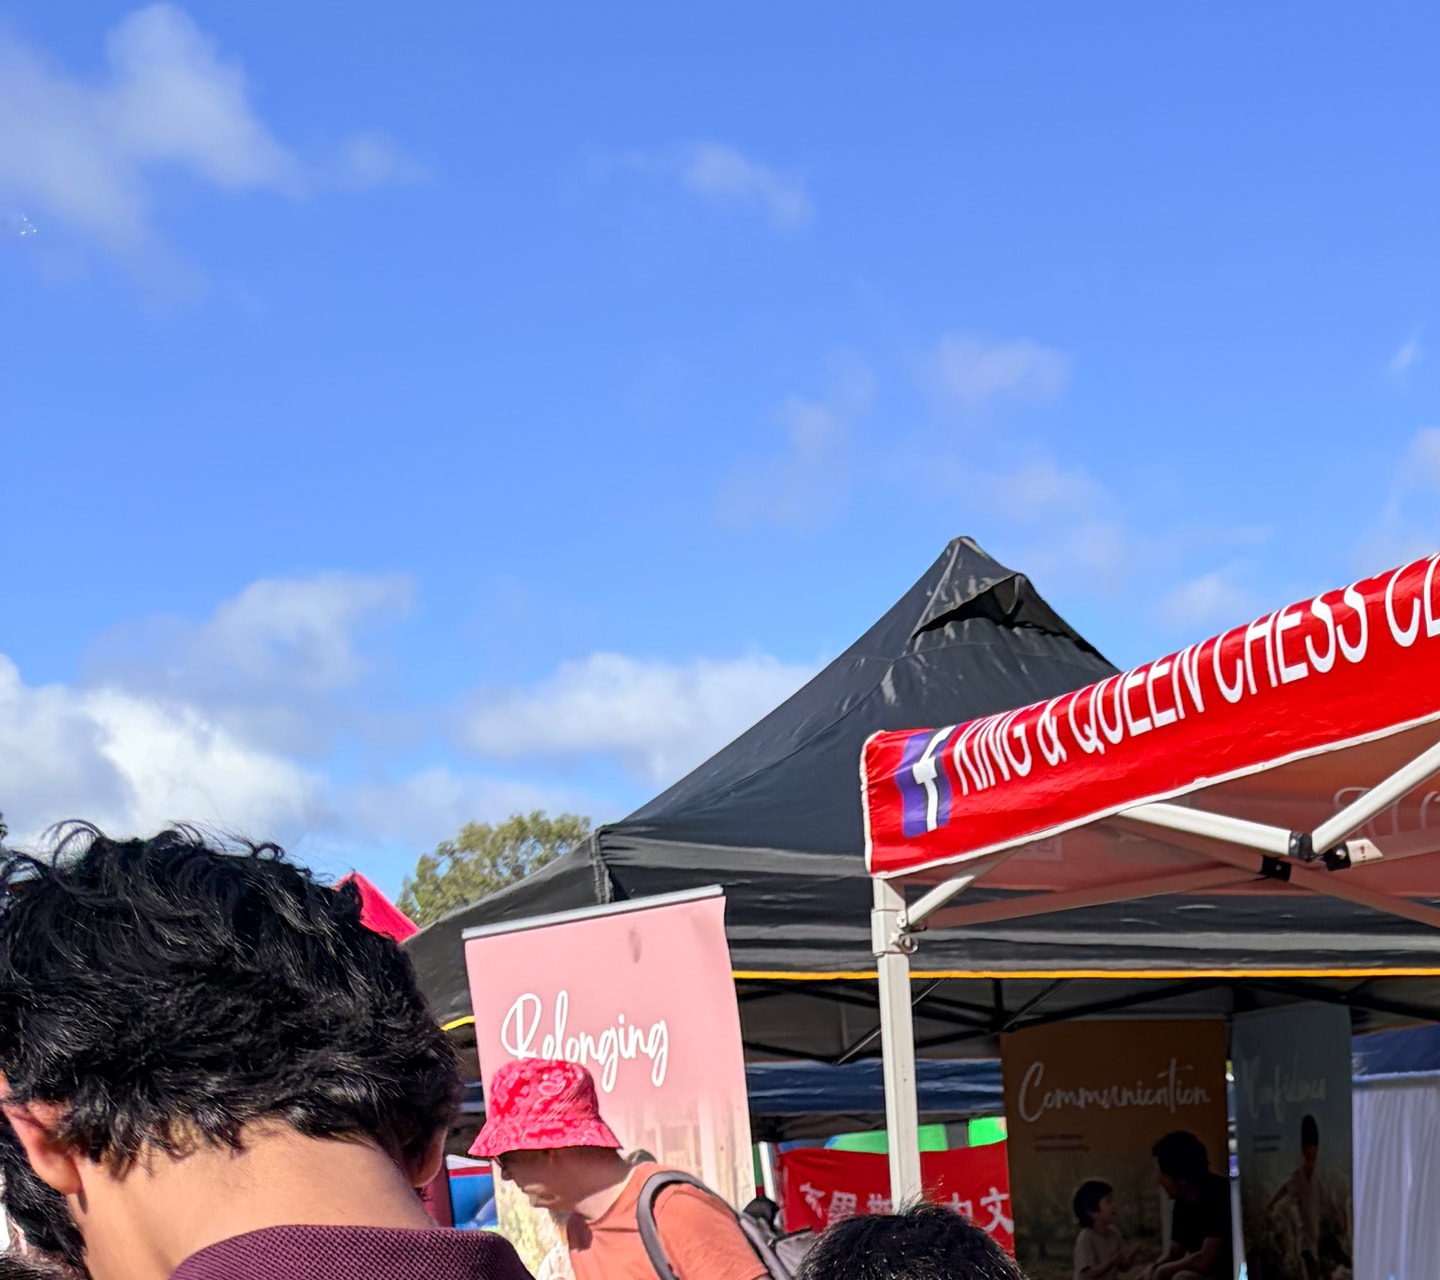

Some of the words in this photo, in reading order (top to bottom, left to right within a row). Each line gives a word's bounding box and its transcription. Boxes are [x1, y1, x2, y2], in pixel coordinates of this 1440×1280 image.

[953, 705, 1033, 796] KING
[1036, 697, 1067, 767] &
[1068, 643, 1205, 756] QUEEN
[1213, 583, 1368, 703] CHESS
[501, 990, 669, 1094] Belonging
[1018, 1056, 1213, 1123] Communication
